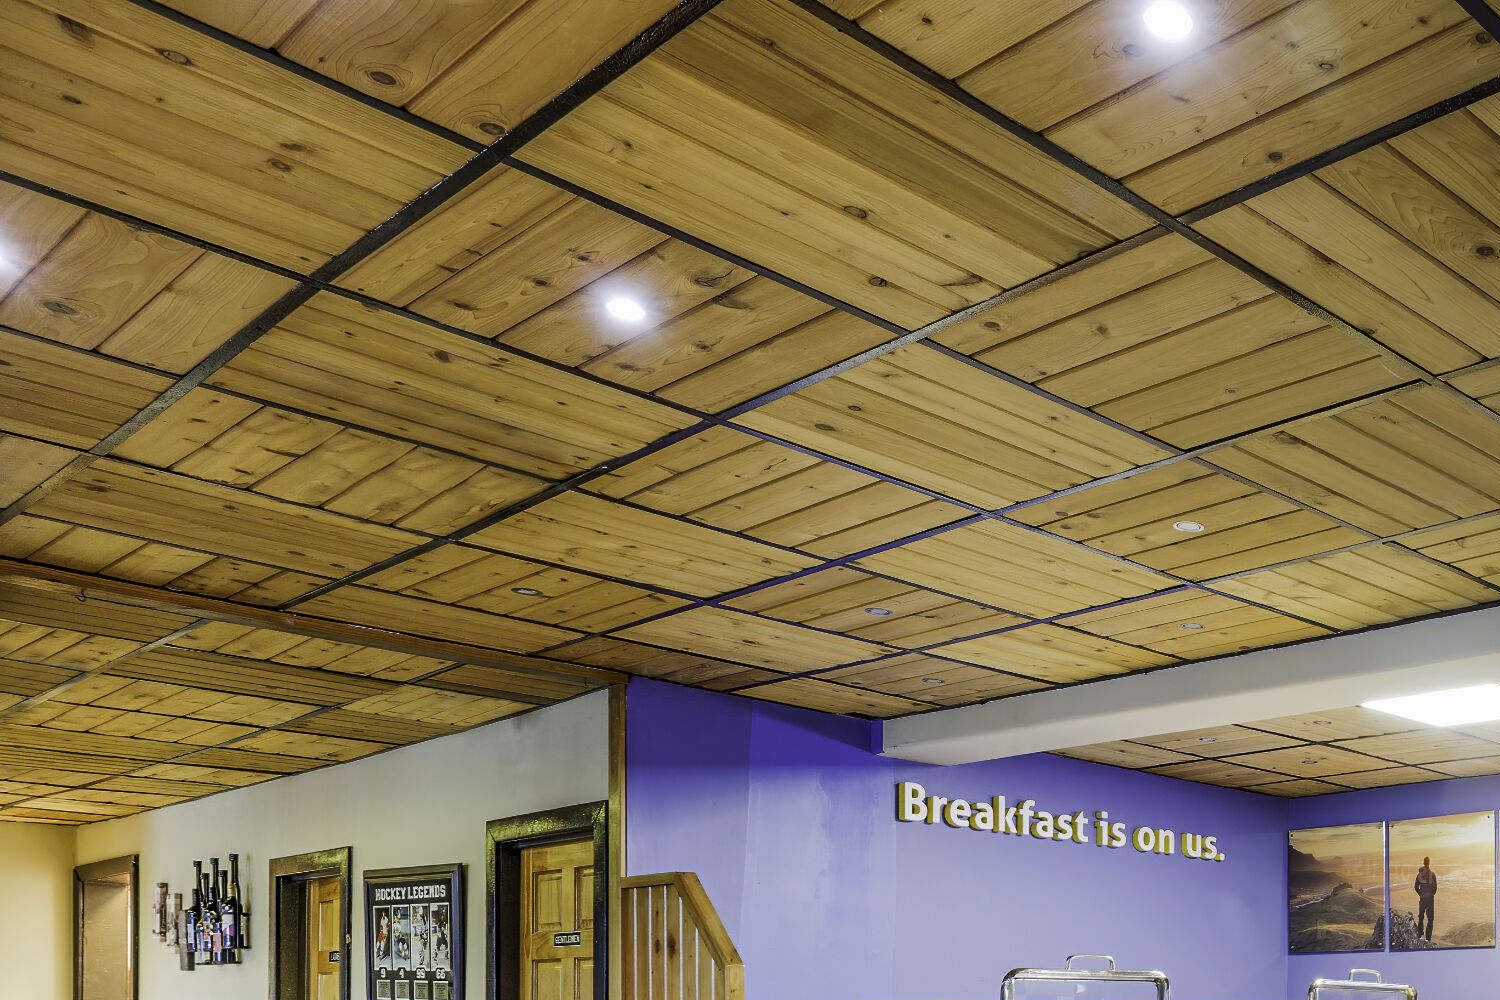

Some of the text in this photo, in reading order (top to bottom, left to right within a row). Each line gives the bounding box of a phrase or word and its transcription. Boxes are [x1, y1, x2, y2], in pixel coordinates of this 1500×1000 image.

[898, 781, 1226, 861] Breakfast is on us.
[375, 885, 446, 901] HOCKEY LEGENDS
[380, 968, 386, 978] 9
[399, 968, 405, 978] 4
